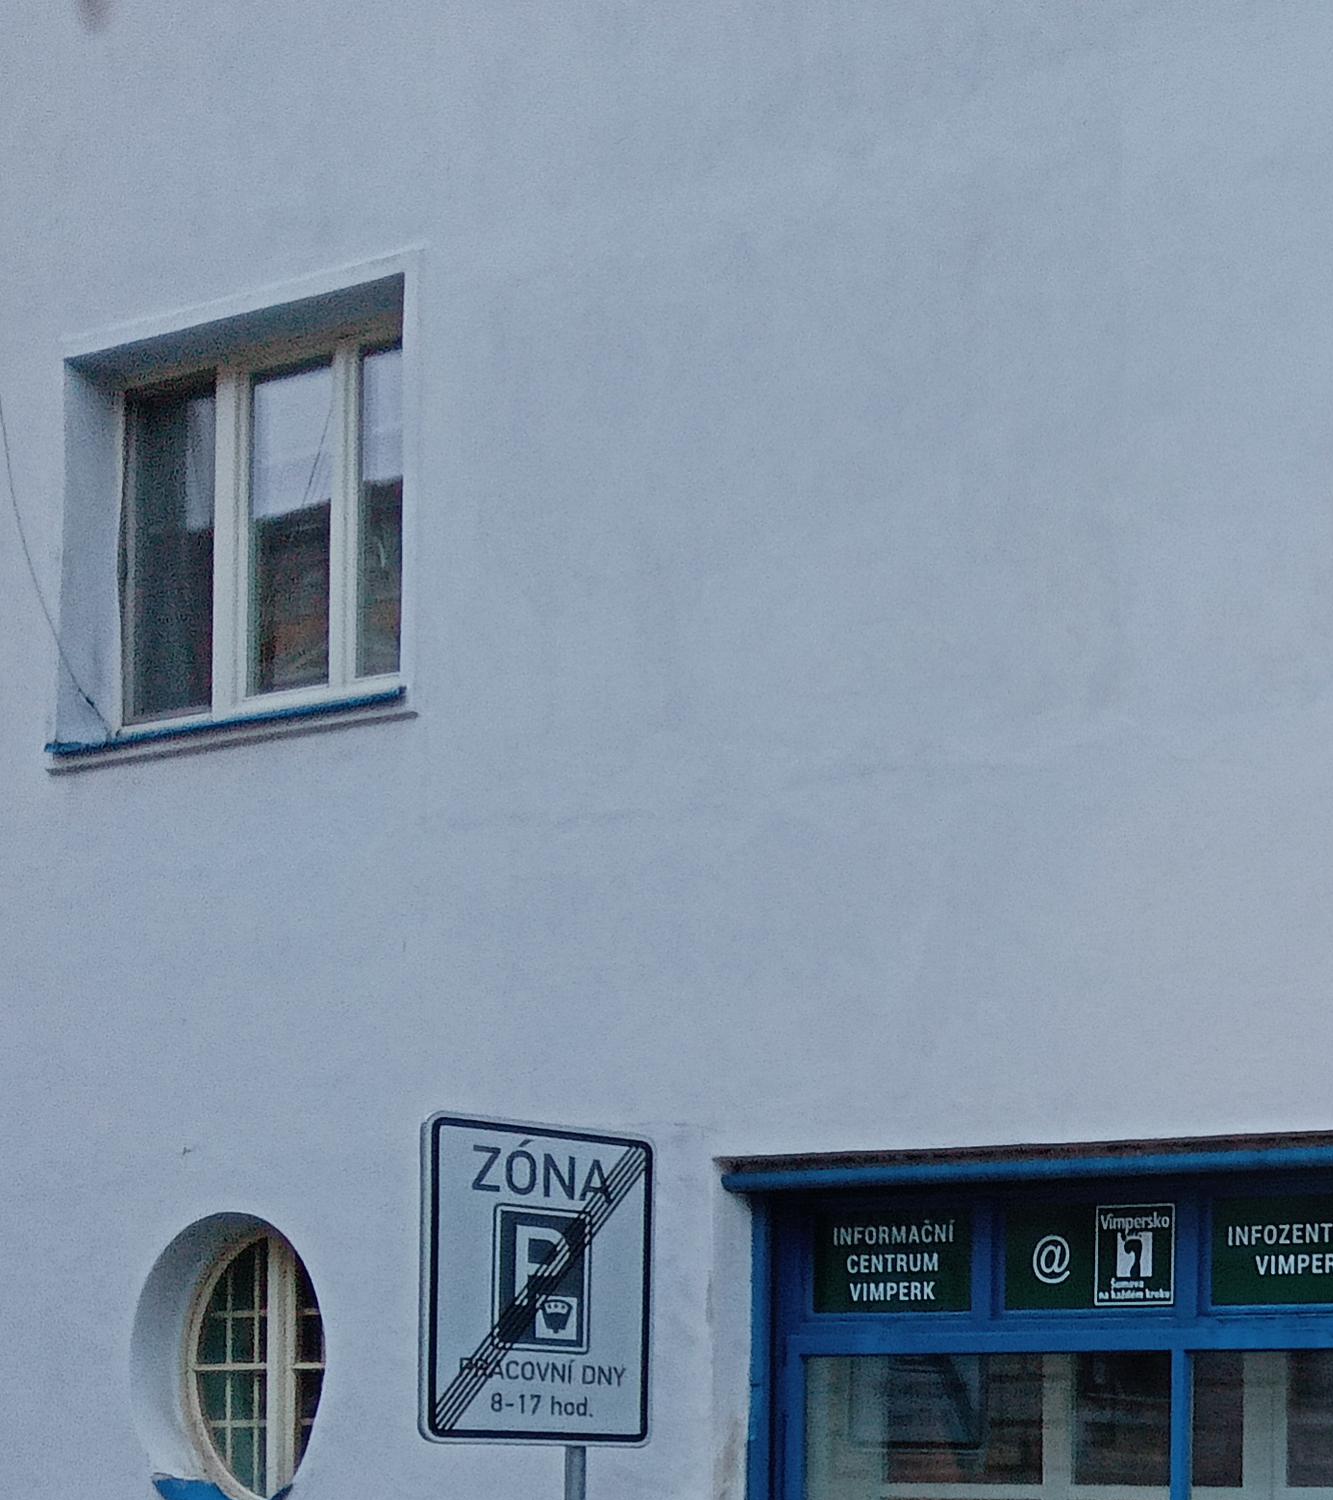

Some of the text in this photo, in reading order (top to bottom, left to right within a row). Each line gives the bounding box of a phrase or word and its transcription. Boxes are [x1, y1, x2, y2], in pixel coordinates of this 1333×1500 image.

[471, 1139, 612, 1202] ZÓNA
[833, 1219, 956, 1247] INFORMAČNÍ
[1100, 1211, 1170, 1234] Vimpersko
[846, 1253, 940, 1274] CENTRUM
[1032, 1235, 1071, 1284] @
[849, 1281, 936, 1301] VIMPERK
[460, 1357, 626, 1387] PRACOVNÍ DNY
[490, 1393, 594, 1418] 8-17 hod.
